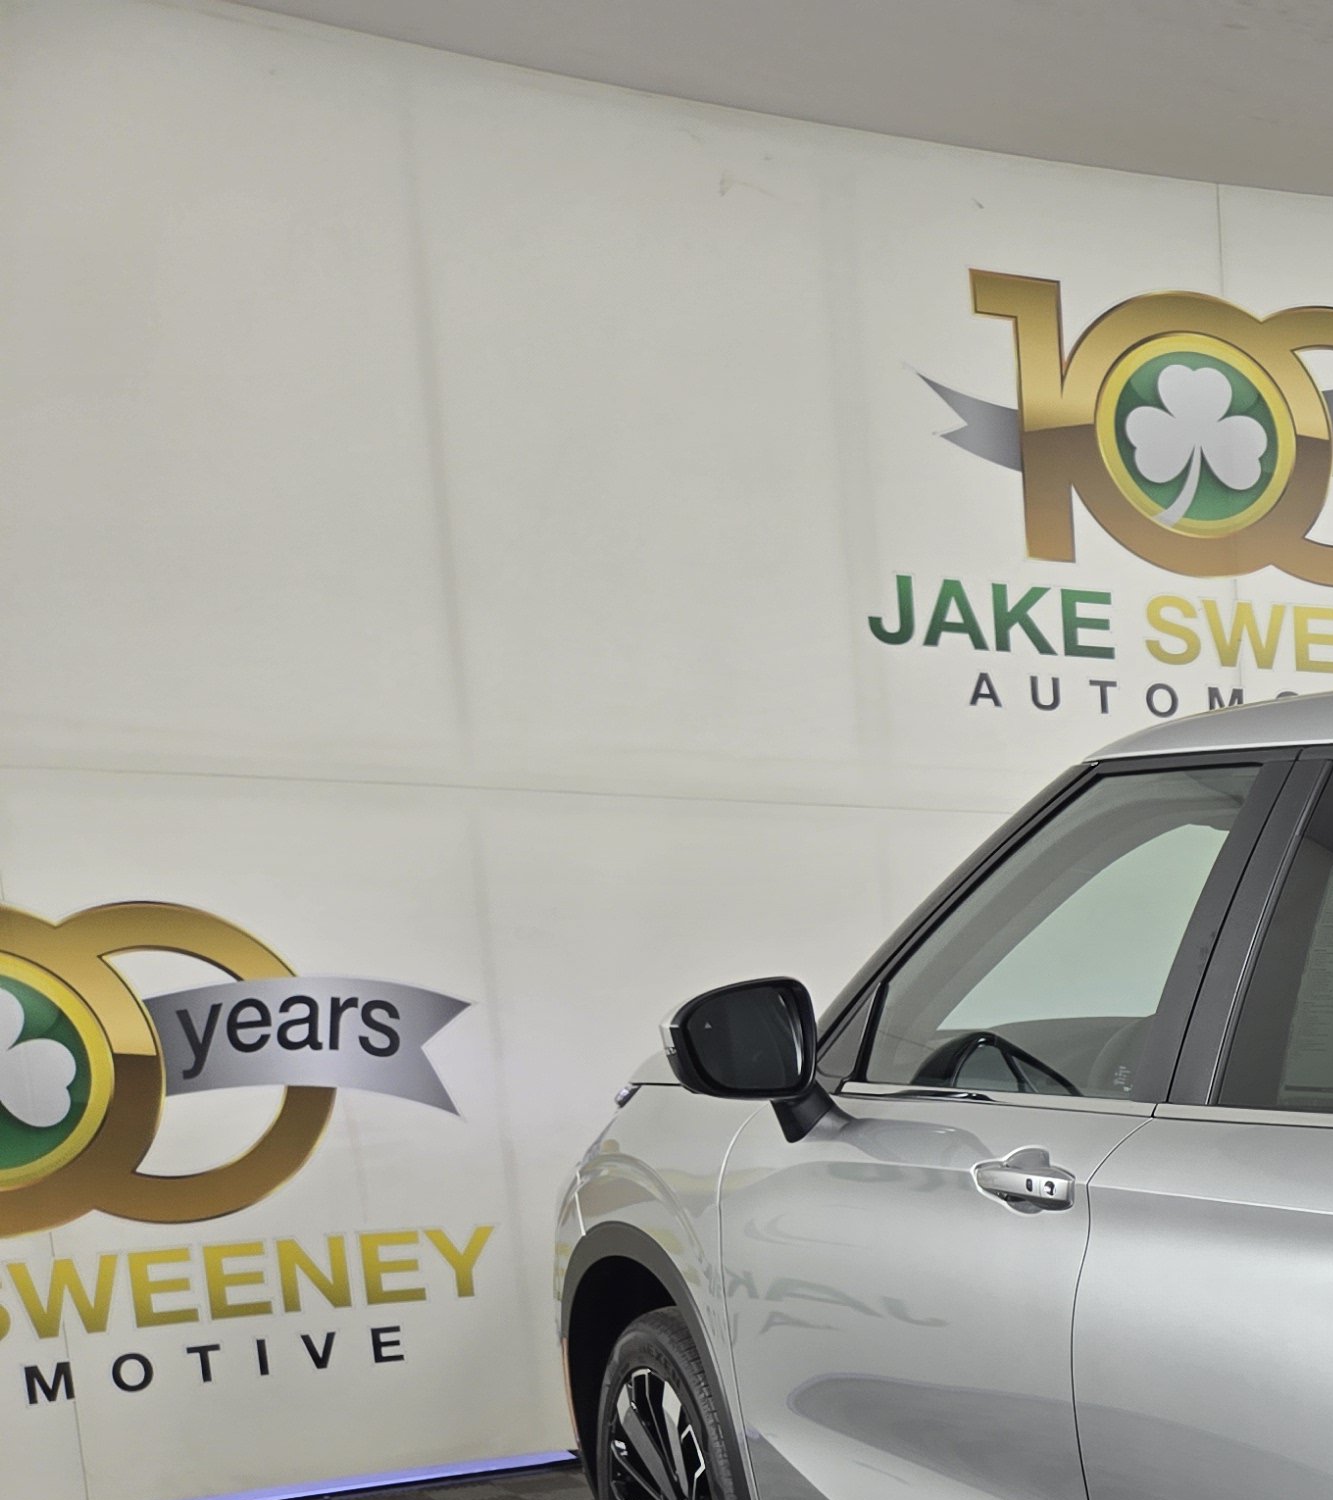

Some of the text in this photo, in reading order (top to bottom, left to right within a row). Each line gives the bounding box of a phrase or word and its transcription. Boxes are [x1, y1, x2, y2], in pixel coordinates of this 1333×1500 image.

[868, 575, 1114, 659] JAKE
[969, 672, 1299, 717] AUTOM
[176, 994, 400, 1079] years
[0, 1226, 494, 1342] WEENEY
